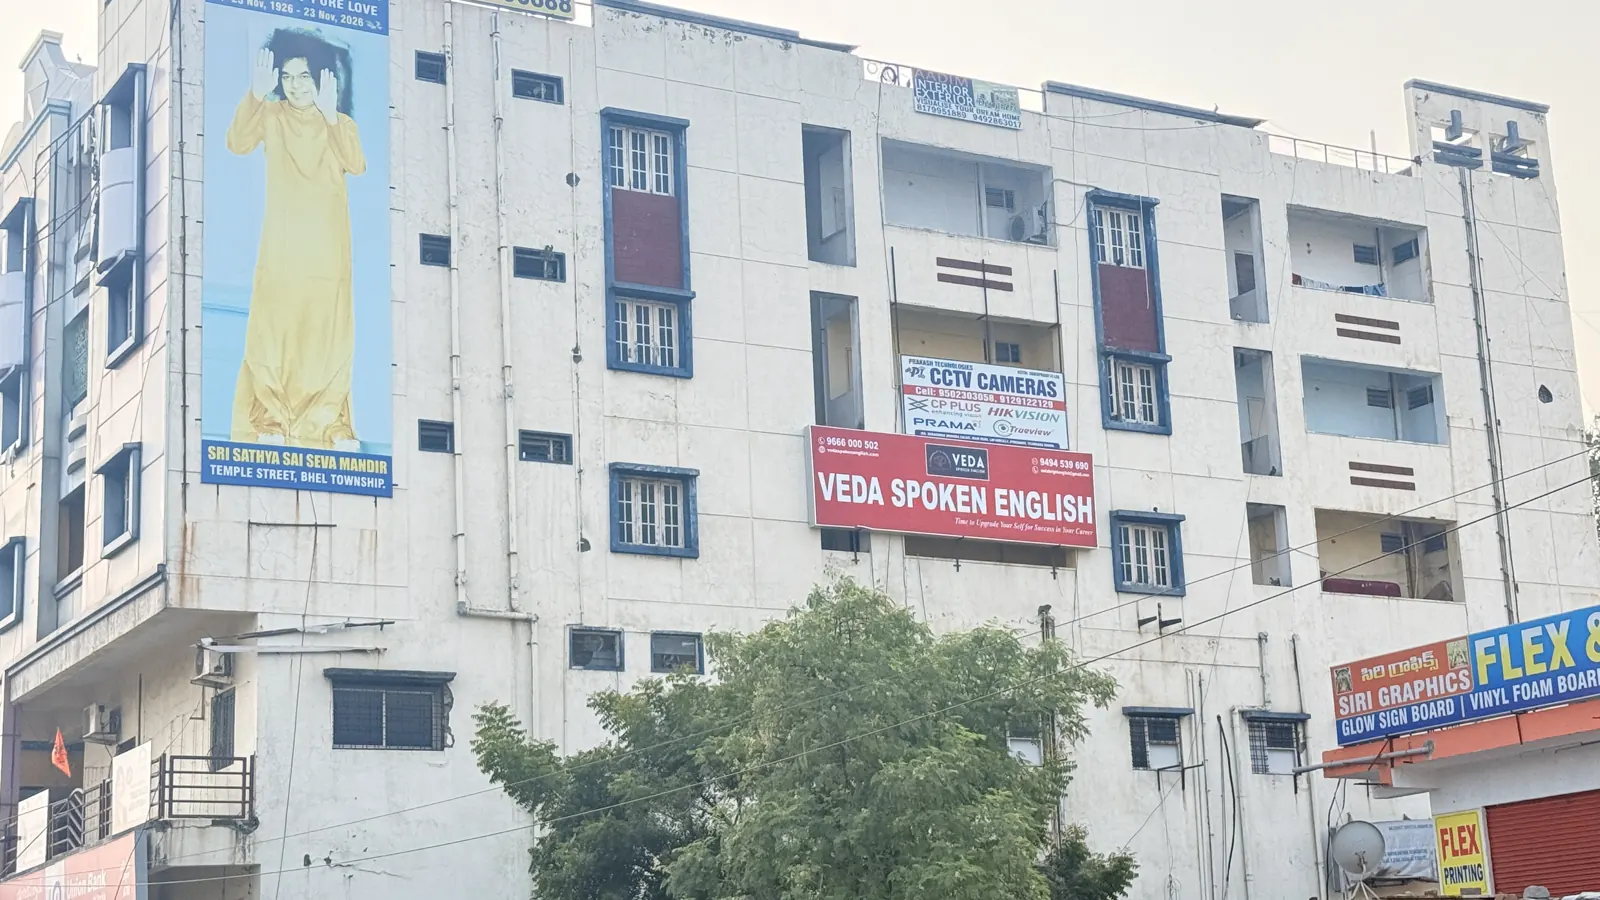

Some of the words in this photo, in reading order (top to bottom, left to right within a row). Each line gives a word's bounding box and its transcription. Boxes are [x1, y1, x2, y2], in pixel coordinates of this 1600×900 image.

[270, 1, 294, 14] 1926
[304, 8, 316, 18] 23
[319, 11, 338, 23] Nov,
[341, 14, 364, 27] 2026
[347, 1, 379, 16] LOVE
[914, 68, 969, 88] AADIM
[914, 78, 969, 97] INTERIOR
[916, 88, 975, 107] EXTERIOR
[956, 105, 974, 114] YOUR
[976, 108, 1000, 118] DREAM
[1002, 113, 1021, 121] HOME
[909, 358, 934, 367] PRAKASH
[935, 360, 973, 371] TECHNOLOGIES
[915, 386, 937, 396] Cell:
[930, 367, 972, 388] CCTV
[977, 372, 1058, 398] CAMERAS
[931, 399, 948, 410] CP
[950, 401, 981, 413] PLUS
[931, 409, 963, 418] enhancing
[988, 407, 1060, 423] HIKVISION
[913, 417, 976, 431] PRAMA
[826, 437, 846, 447] 9666
[848, 439, 863, 448] 000
[864, 440, 879, 450] 502
[208, 445, 230, 460] SRI
[233, 447, 280, 465] SATHYA
[282, 451, 303, 467] SAI
[306, 453, 337, 470] SEVA
[339, 456, 388, 474] MANDIR
[952, 453, 985, 469] VEDA
[1039, 457, 1058, 468] 9494
[1060, 459, 1074, 469] 539
[1075, 461, 1089, 471] 690
[210, 464, 253, 479] TEMPLE
[256, 468, 298, 483] STREET,
[300, 471, 328, 484] BHEL
[330, 474, 387, 489] TOWNSHIP.
[818, 472, 884, 505] VEDA
[891, 478, 987, 514] SPOKEN
[995, 487, 1093, 524] ENGLISH
[955, 517, 969, 525] Time
[969, 518, 975, 526] to
[976, 518, 999, 528] Upgrade
[1000, 521, 1013, 529] Your
[1013, 522, 1025, 531] Self
[1024, 523, 1034, 532] for
[1034, 524, 1055, 533] Success
[1062, 526, 1075, 535] Your
[1474, 619, 1576, 685] FLEX
[1338, 692, 1373, 716] SIRI
[1378, 669, 1471, 708] GRAPHICS
[1469, 687, 1509, 711] VINYL
[1513, 678, 1554, 702] FOAM
[1341, 716, 1375, 736] GLOW
[1379, 707, 1408, 729] SIGN
[1412, 698, 1454, 721] BOARD
[1440, 823, 1480, 863] FLEX
[1444, 863, 1484, 885] PRINTING
[67, 876, 87, 900] Union
[87, 868, 107, 893] Bank
